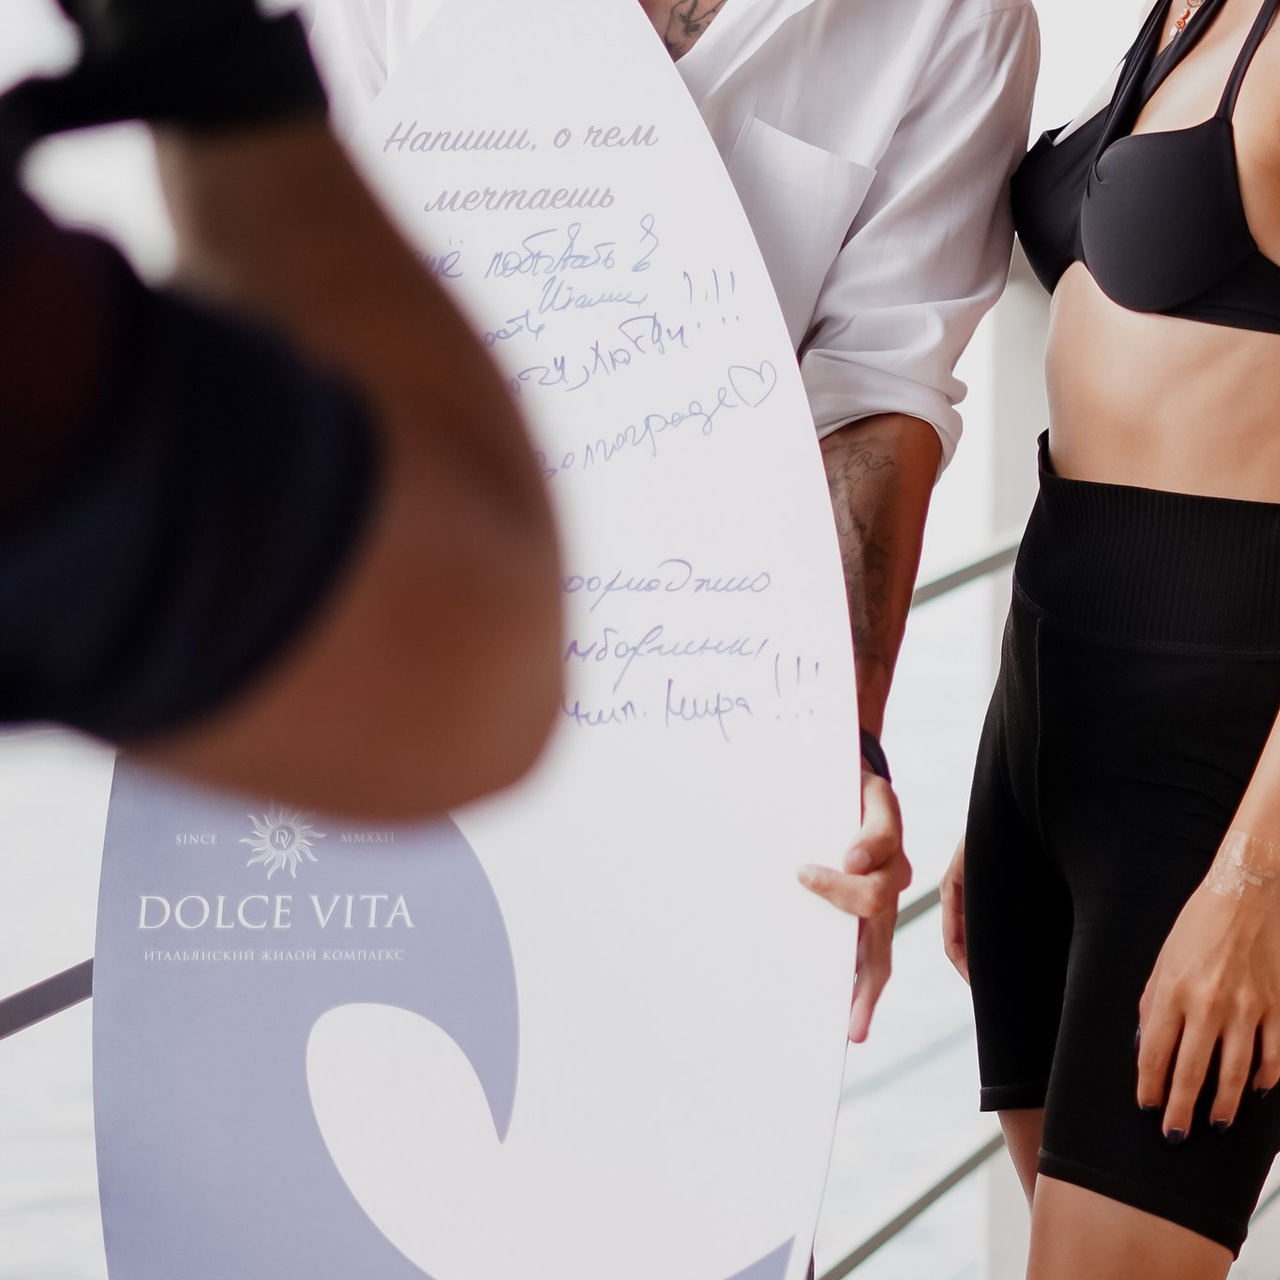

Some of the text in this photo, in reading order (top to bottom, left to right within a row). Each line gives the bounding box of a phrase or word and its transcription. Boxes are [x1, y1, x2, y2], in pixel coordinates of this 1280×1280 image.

[383, 120, 659, 153] Напиши, о чем
[423, 187, 615, 213] мечтаешь
[175, 834, 218, 846] SINCE
[340, 832, 396, 844] MMXXII
[137, 893, 416, 930] DOLCE VITA
[143, 948, 405, 962] ИТАЛЬЯНСКИЙ ЖИЛОЙ КОМПЛЕКС
